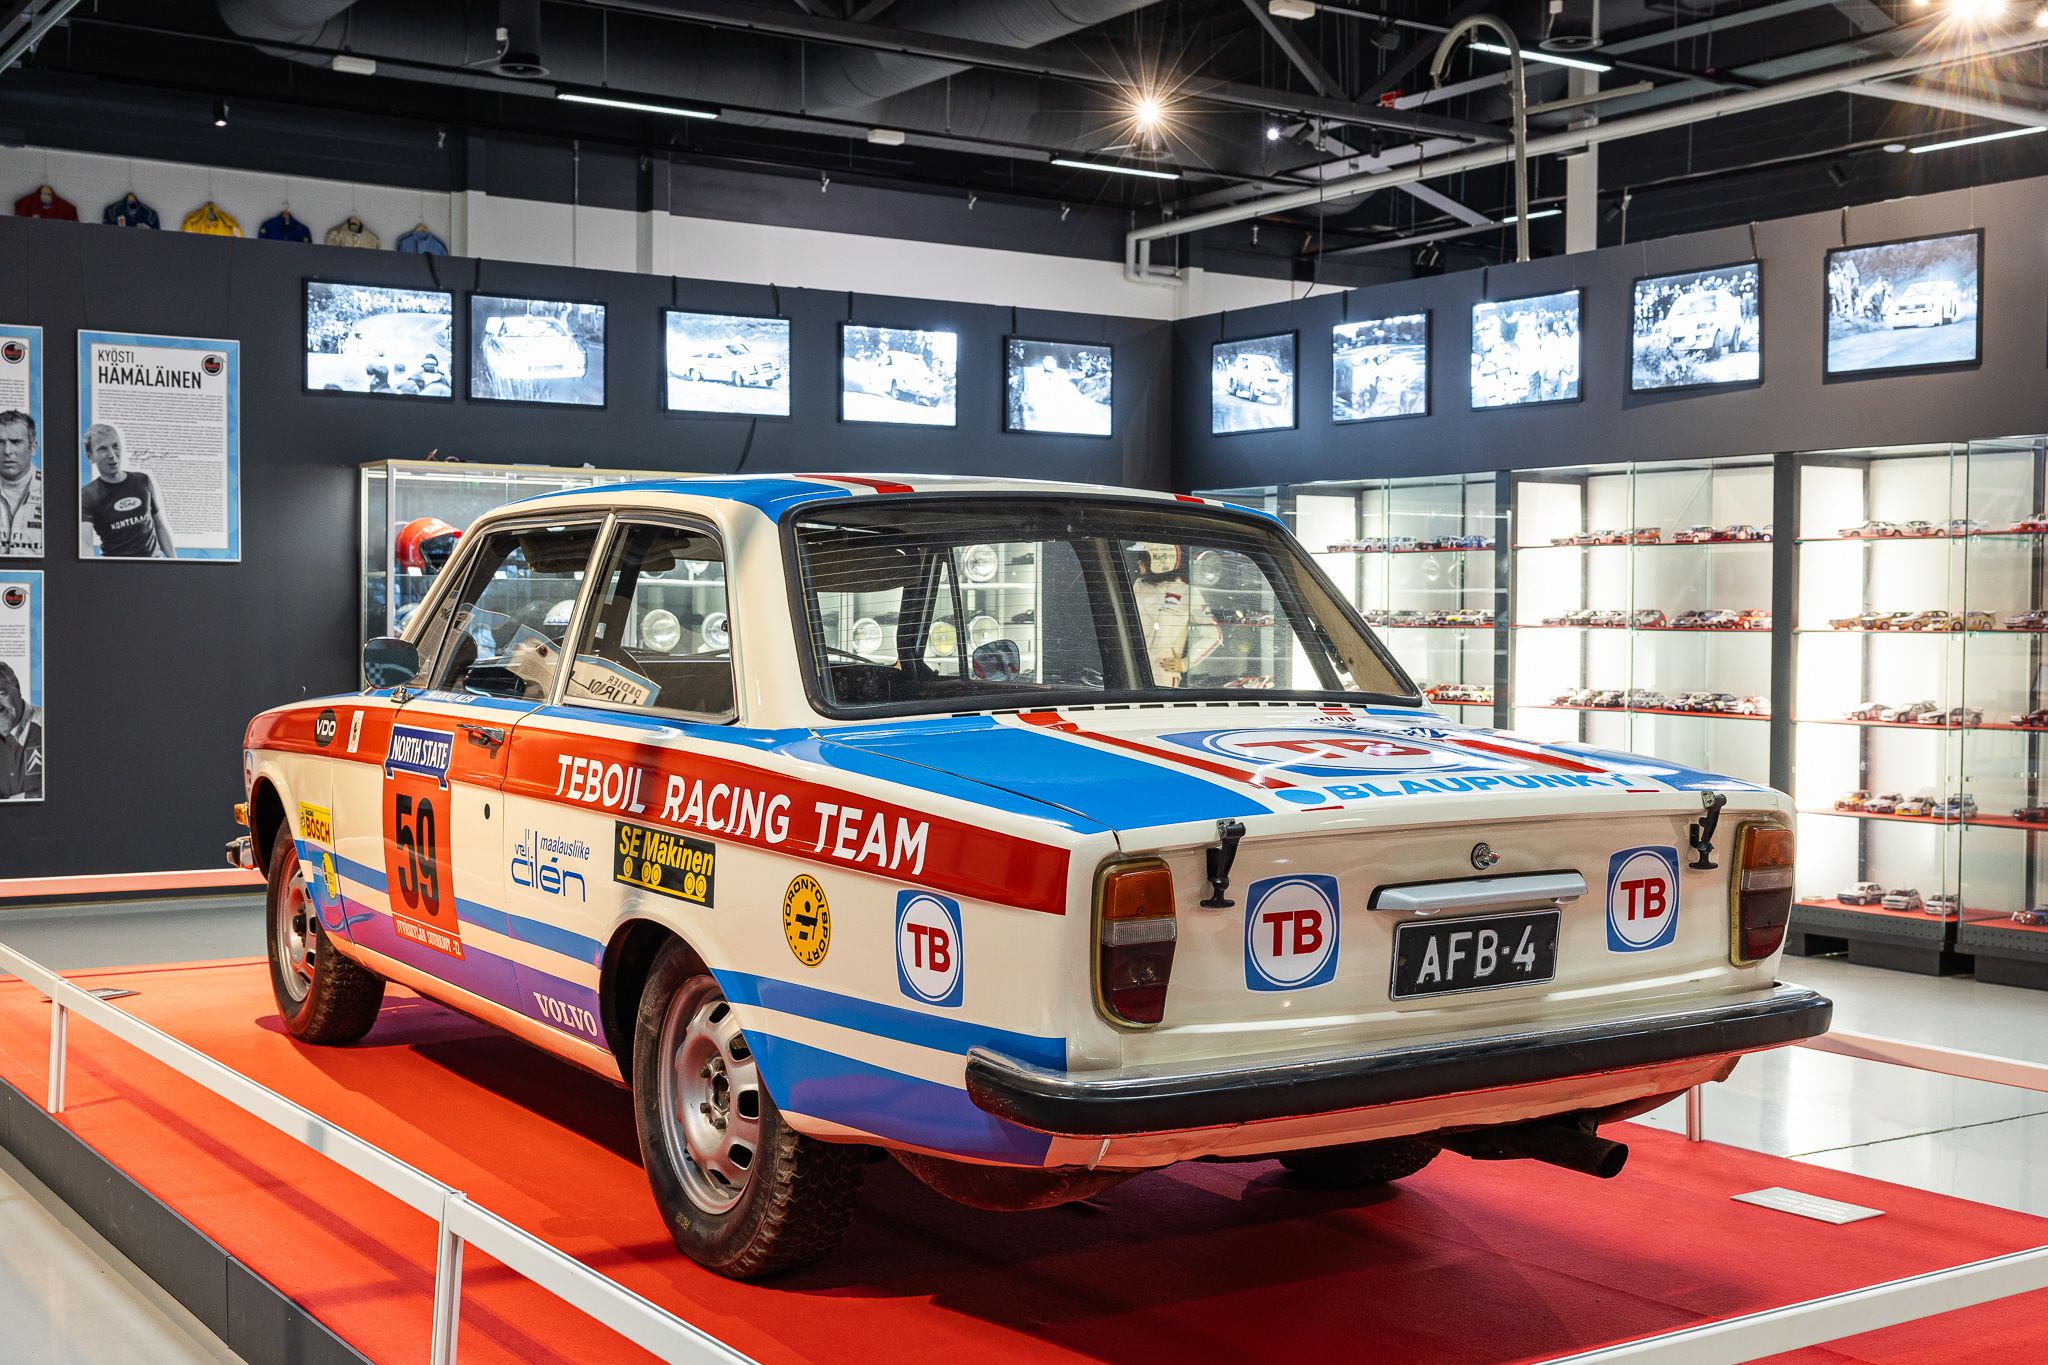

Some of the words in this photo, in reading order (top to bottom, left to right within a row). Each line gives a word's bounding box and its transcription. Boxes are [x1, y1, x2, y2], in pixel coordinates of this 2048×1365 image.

[98, 348, 134, 363] KYÖSTI
[99, 363, 202, 389] HÄMÄLÄINEN
[316, 719, 336, 736] VDO
[391, 735, 422, 764] NORTH
[420, 740, 448, 769] STATE
[305, 816, 331, 843] BOSCH
[555, 754, 646, 814] TEBOIL
[660, 774, 792, 844] RACING
[813, 801, 930, 876] TEAM
[396, 793, 440, 917] 59
[540, 836, 590, 860] maalausliike
[619, 826, 642, 858] SE
[642, 831, 714, 877] Mäkinen
[785, 878, 823, 930] TORONTO
[806, 911, 829, 961] SPORT
[1621, 877, 1667, 921] TB
[906, 922, 951, 973] TB
[1262, 909, 1323, 957] TB
[1415, 924, 1536, 984] AFB-4
[533, 991, 597, 1037] VOLVO
